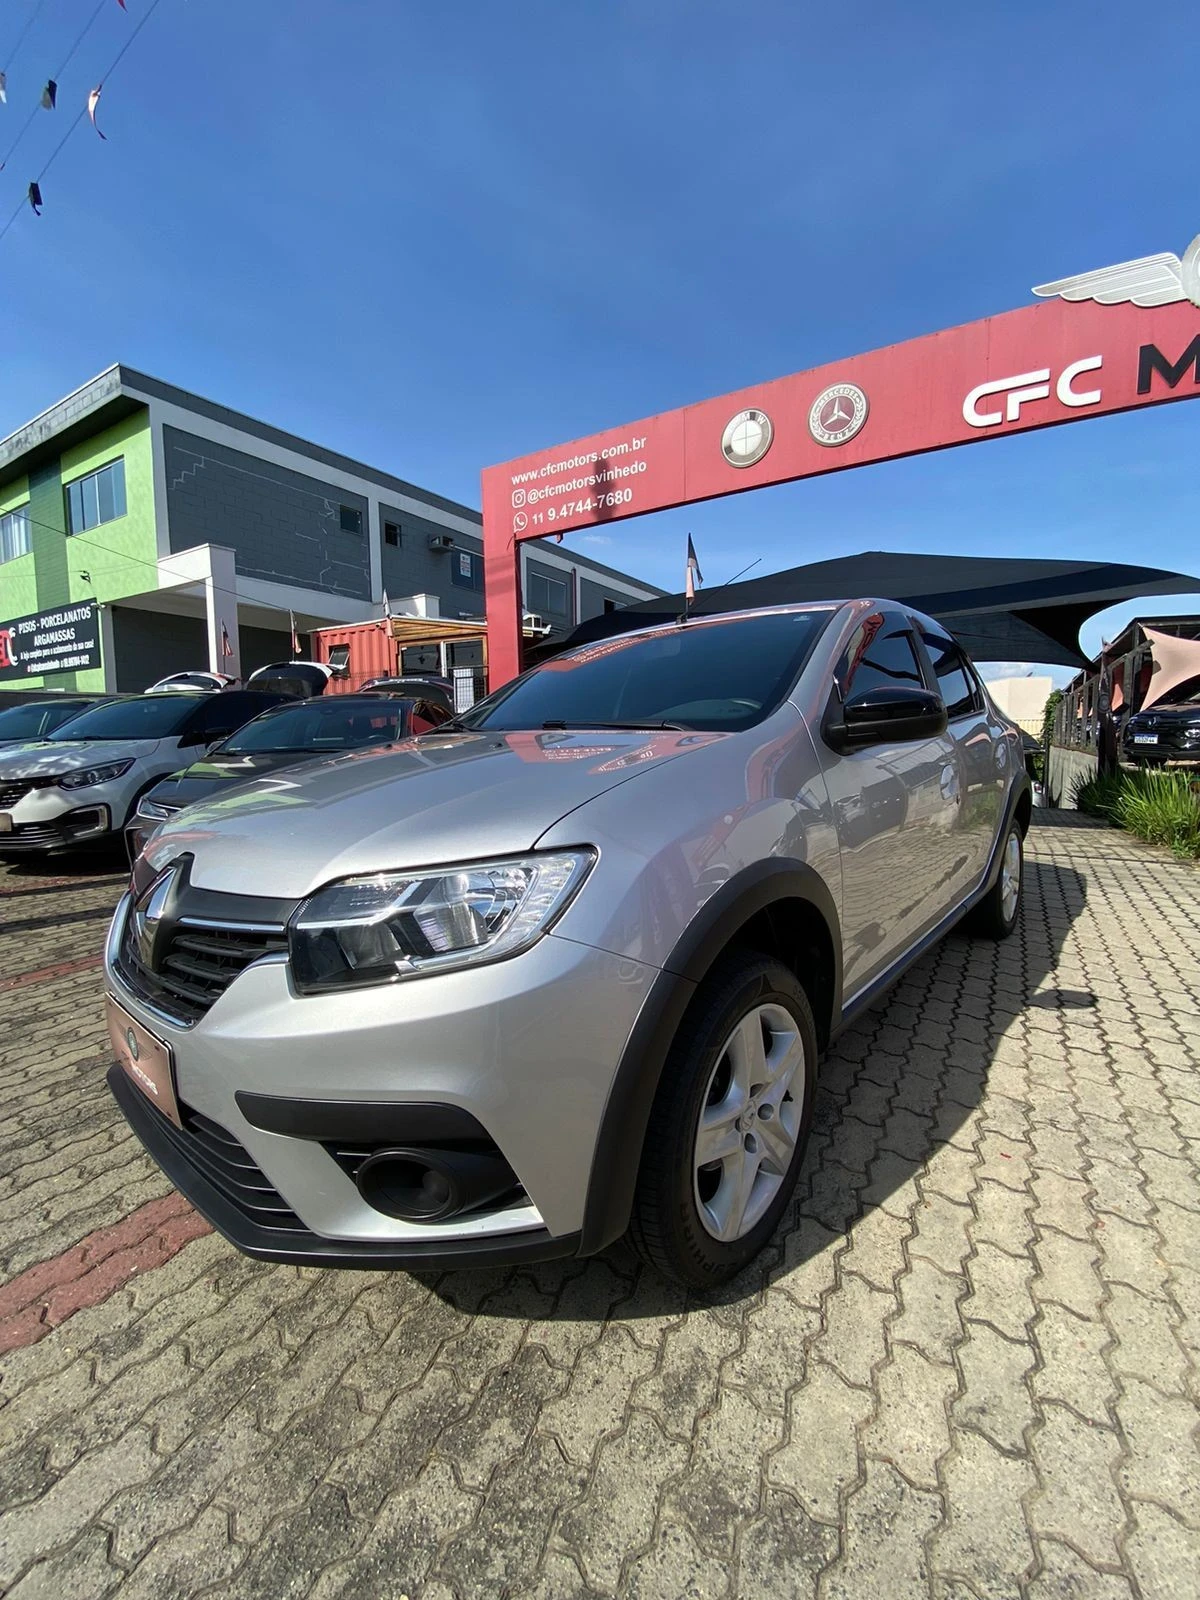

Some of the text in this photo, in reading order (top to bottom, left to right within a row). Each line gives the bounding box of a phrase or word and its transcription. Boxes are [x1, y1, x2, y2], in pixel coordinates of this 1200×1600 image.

[819, 386, 859, 409] MERCEDES
[962, 355, 1102, 428] CFC
[824, 429, 851, 442] BENZ
[511, 436, 647, 485] www.cfcmotors.com.br
[527, 461, 647, 504] @cfcmotorsvinhedo
[532, 488, 632, 525] 11 9.4744-7680
[18, 620, 36, 634] PISOS
[40, 606, 91, 629] PORCELANATOS
[34, 627, 76, 647] ARGAMASSAS
